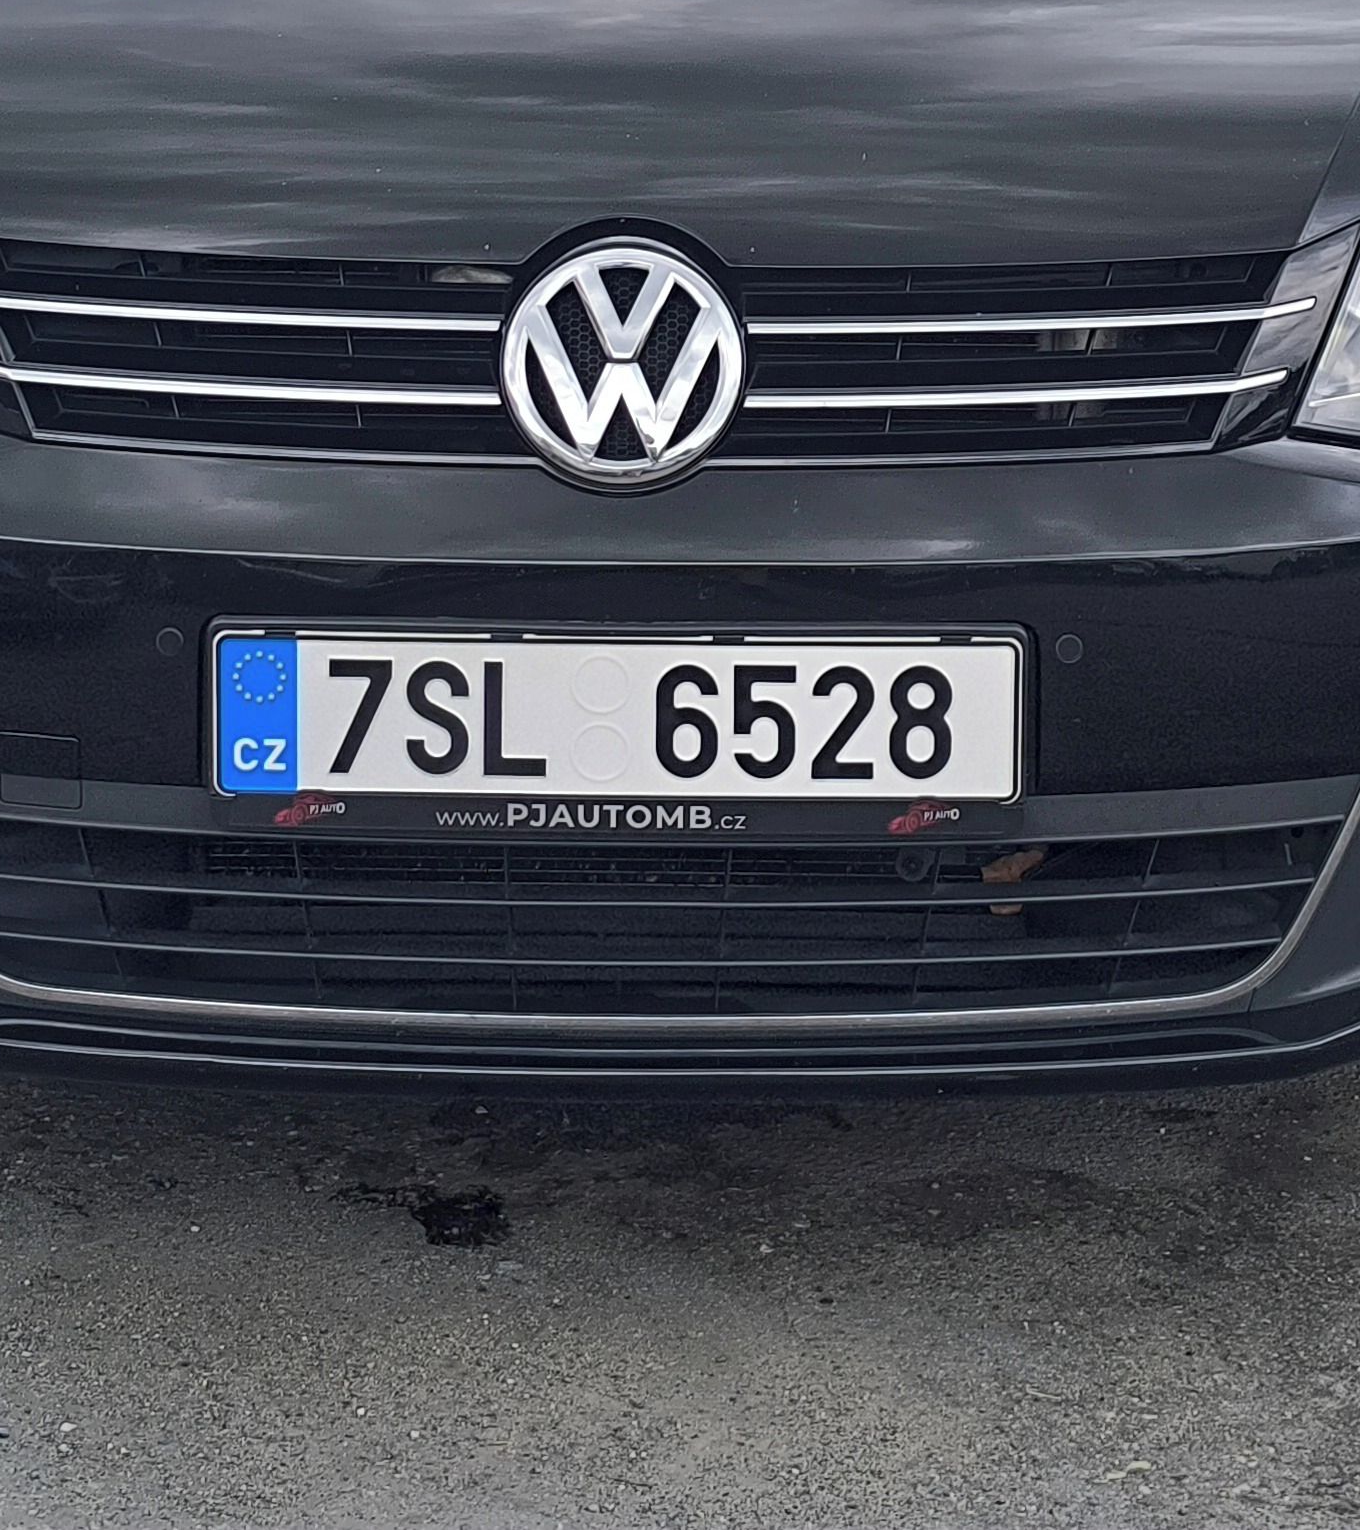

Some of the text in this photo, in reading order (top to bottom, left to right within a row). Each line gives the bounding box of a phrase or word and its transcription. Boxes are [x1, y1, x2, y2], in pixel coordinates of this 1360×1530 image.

[515, 252, 732, 470] VW
[327, 657, 953, 781] 7SL 6528
[232, 738, 288, 772] CZ
[321, 802, 346, 814] AUTO
[435, 802, 747, 830] www.PJAUTOMB.cz
[923, 808, 960, 821] PJ AUTO
